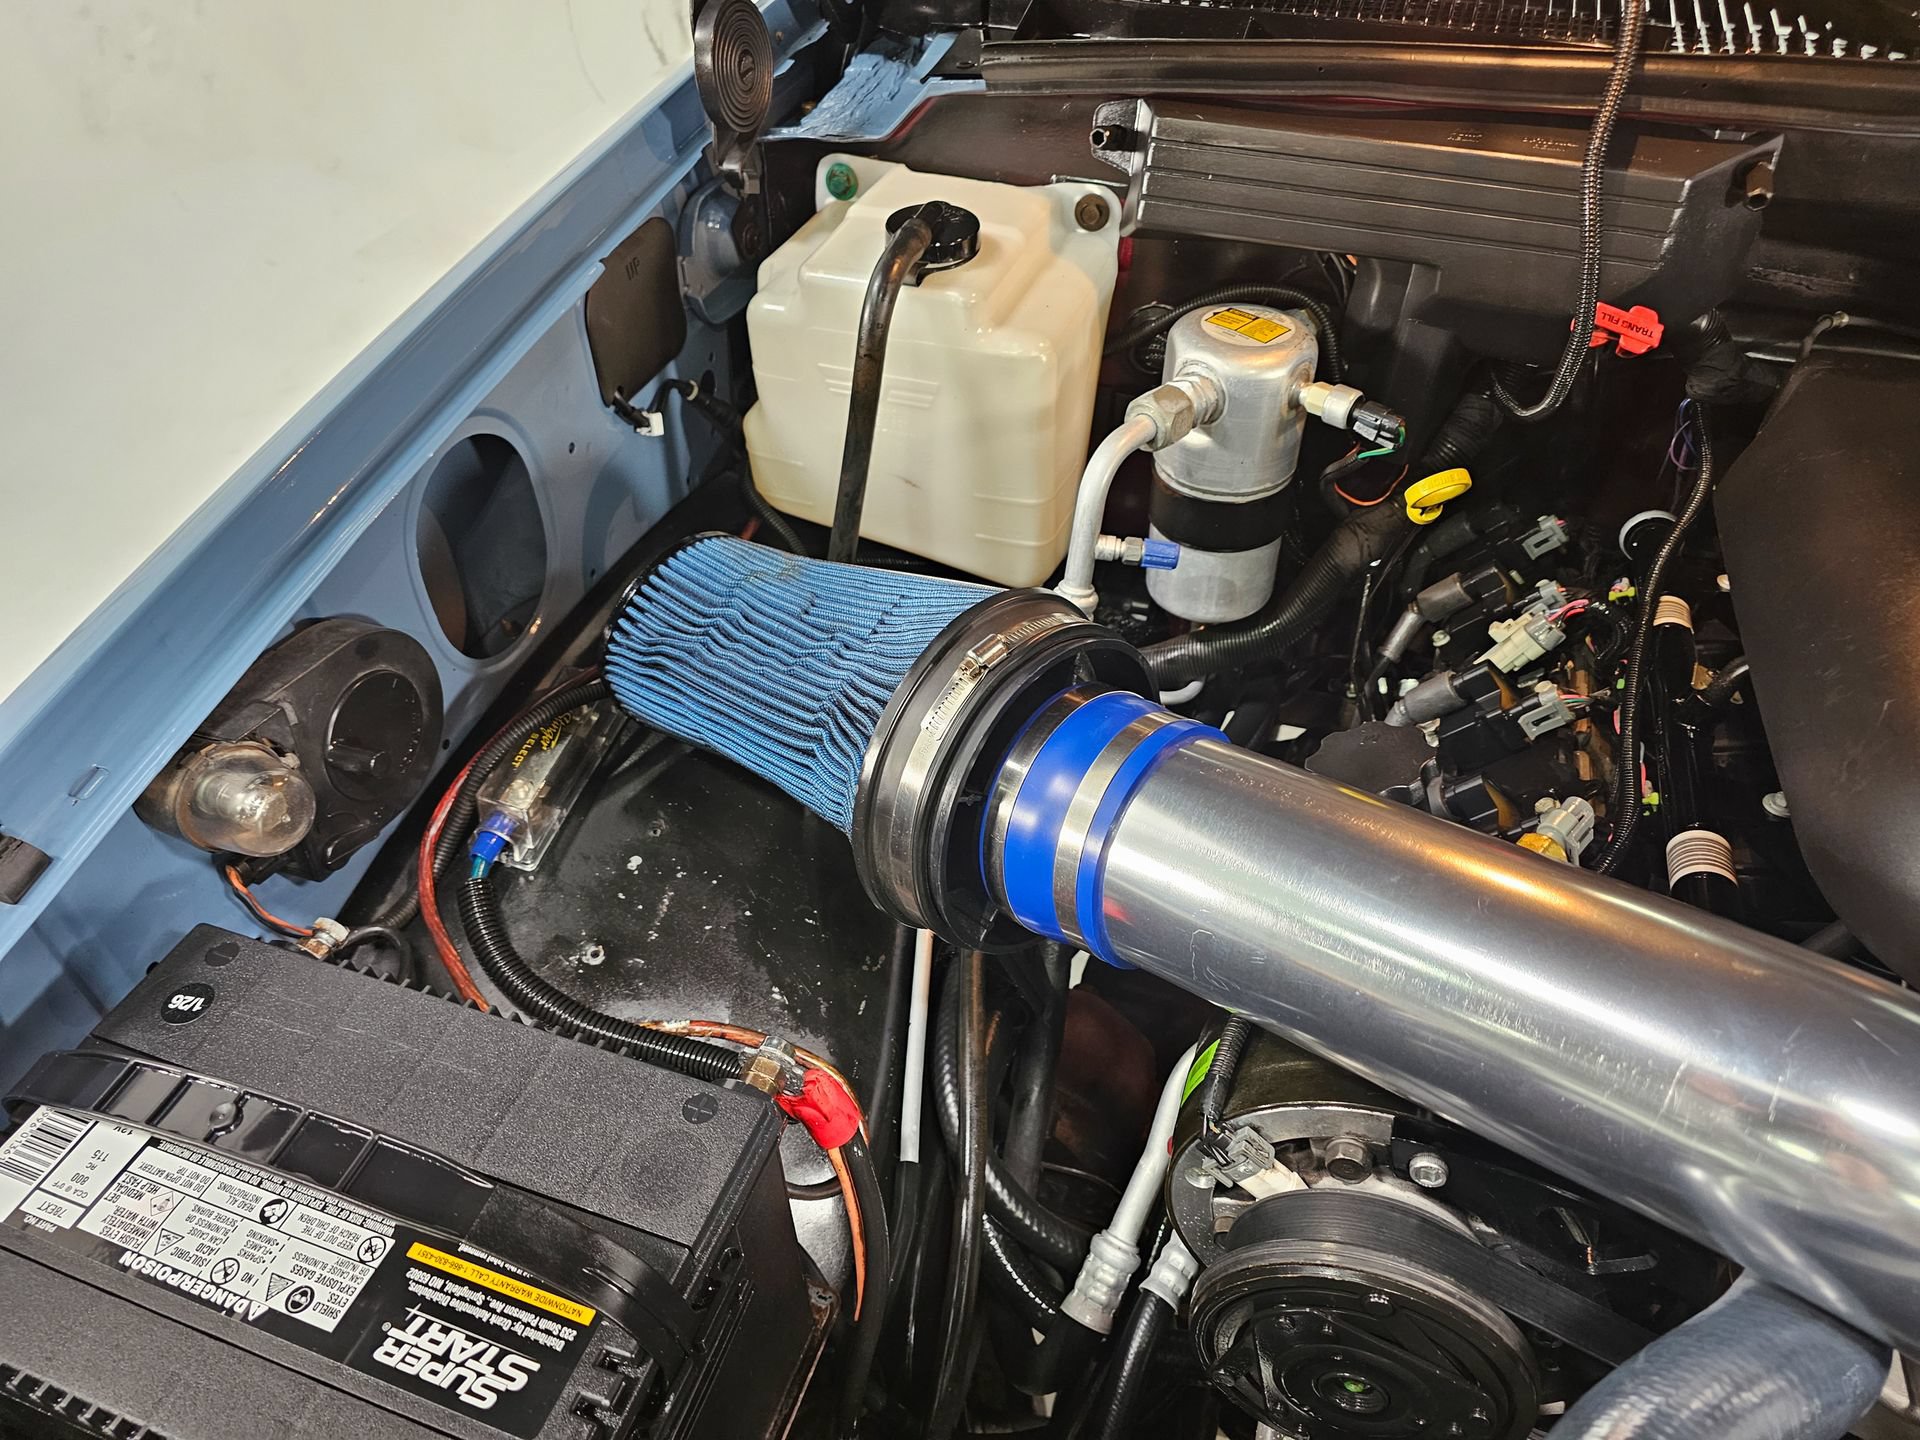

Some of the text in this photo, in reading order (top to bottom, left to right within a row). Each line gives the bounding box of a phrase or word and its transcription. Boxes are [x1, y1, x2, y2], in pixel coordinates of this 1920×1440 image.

[1601, 311, 1653, 337] TRANS FILL
[540, 712, 573, 752] Stinger
[512, 733, 539, 768] SELECT
[167, 994, 204, 1011] 1/26
[90, 1149, 111, 1162] 115
[155, 1139, 192, 1159] INCINERATE.
[189, 1152, 202, 1162] OR
[84, 1161, 97, 1170] RC
[174, 1165, 211, 1184] DO NOT TIP.
[197, 1155, 239, 1177] DISASSEMBLE
[69, 1172, 90, 1185] 800
[119, 1173, 160, 1194] HELP FAST.
[136, 1160, 205, 1192] DO NOT OPEN BATTERY.
[235, 1170, 252, 1181] NOT
[248, 1175, 261, 1185] DO
[71, 1188, 89, 1198] CCA
[103, 1191, 121, 1203] GET
[111, 1182, 145, 1200] MEDICAL
[214, 1180, 262, 1204] INSTRUCTIONS.
[279, 1187, 293, 1197] OR
[289, 1190, 325, 1210] EXPLOSION
[36, 1199, 68, 1218] 78EXT
[224, 1195, 256, 1212] READ ALL
[21, 1213, 57, 1232] PART NO.
[109, 1204, 159, 1229] WITH WATER.
[188, 1203, 238, 1227] SEVERE BURNS.
[336, 1209, 350, 1219] OF
[346, 1212, 365, 1225] RISK
[100, 1213, 151, 1239] IMMEDIATELY
[184, 1213, 231, 1236] BLINDNESS OR
[295, 1211, 361, 1242] REACH OF CHILDREN.
[361, 1217, 395, 1236] WARNING:
[98, 1225, 143, 1248] FLUSH EYES
[186, 1226, 223, 1245] CAN CAUSE
[300, 1225, 355, 1251] KEEP OUT OF THE
[168, 1246, 208, 1267] SULFURIC
[194, 1242, 216, 1256] ACID
[454, 1242, 488, 1261] removed.
[290, 1250, 364, 1284] CAN CAUSE BLINDNESS
[332, 1256, 370, 1275] OR INJURY.
[416, 1248, 469, 1273] 1-866-830-4351
[116, 1249, 251, 1313] DANGER/POISON
[239, 1271, 255, 1283] NO
[289, 1263, 357, 1296] EXPLOSIVE GASES
[404, 1266, 432, 1283] 65802
[427, 1275, 445, 1288] MO
[468, 1268, 490, 1281] CALL
[440, 1279, 487, 1305] Springfield,
[489, 1276, 533, 1297] WARRANTY
[323, 1291, 349, 1307] EYES.
[533, 1293, 583, 1317] NATIONWIDE
[310, 1301, 341, 1319] SHIELD
[403, 1280, 567, 1351] Distributed by: Ozark Automotive Distributors,
[501, 1304, 540, 1325] Patterson
[535, 1317, 563, 1335] South
[557, 1325, 578, 1340] 233
[387, 1315, 540, 1390] START
[371, 1335, 507, 1410] SUPER
